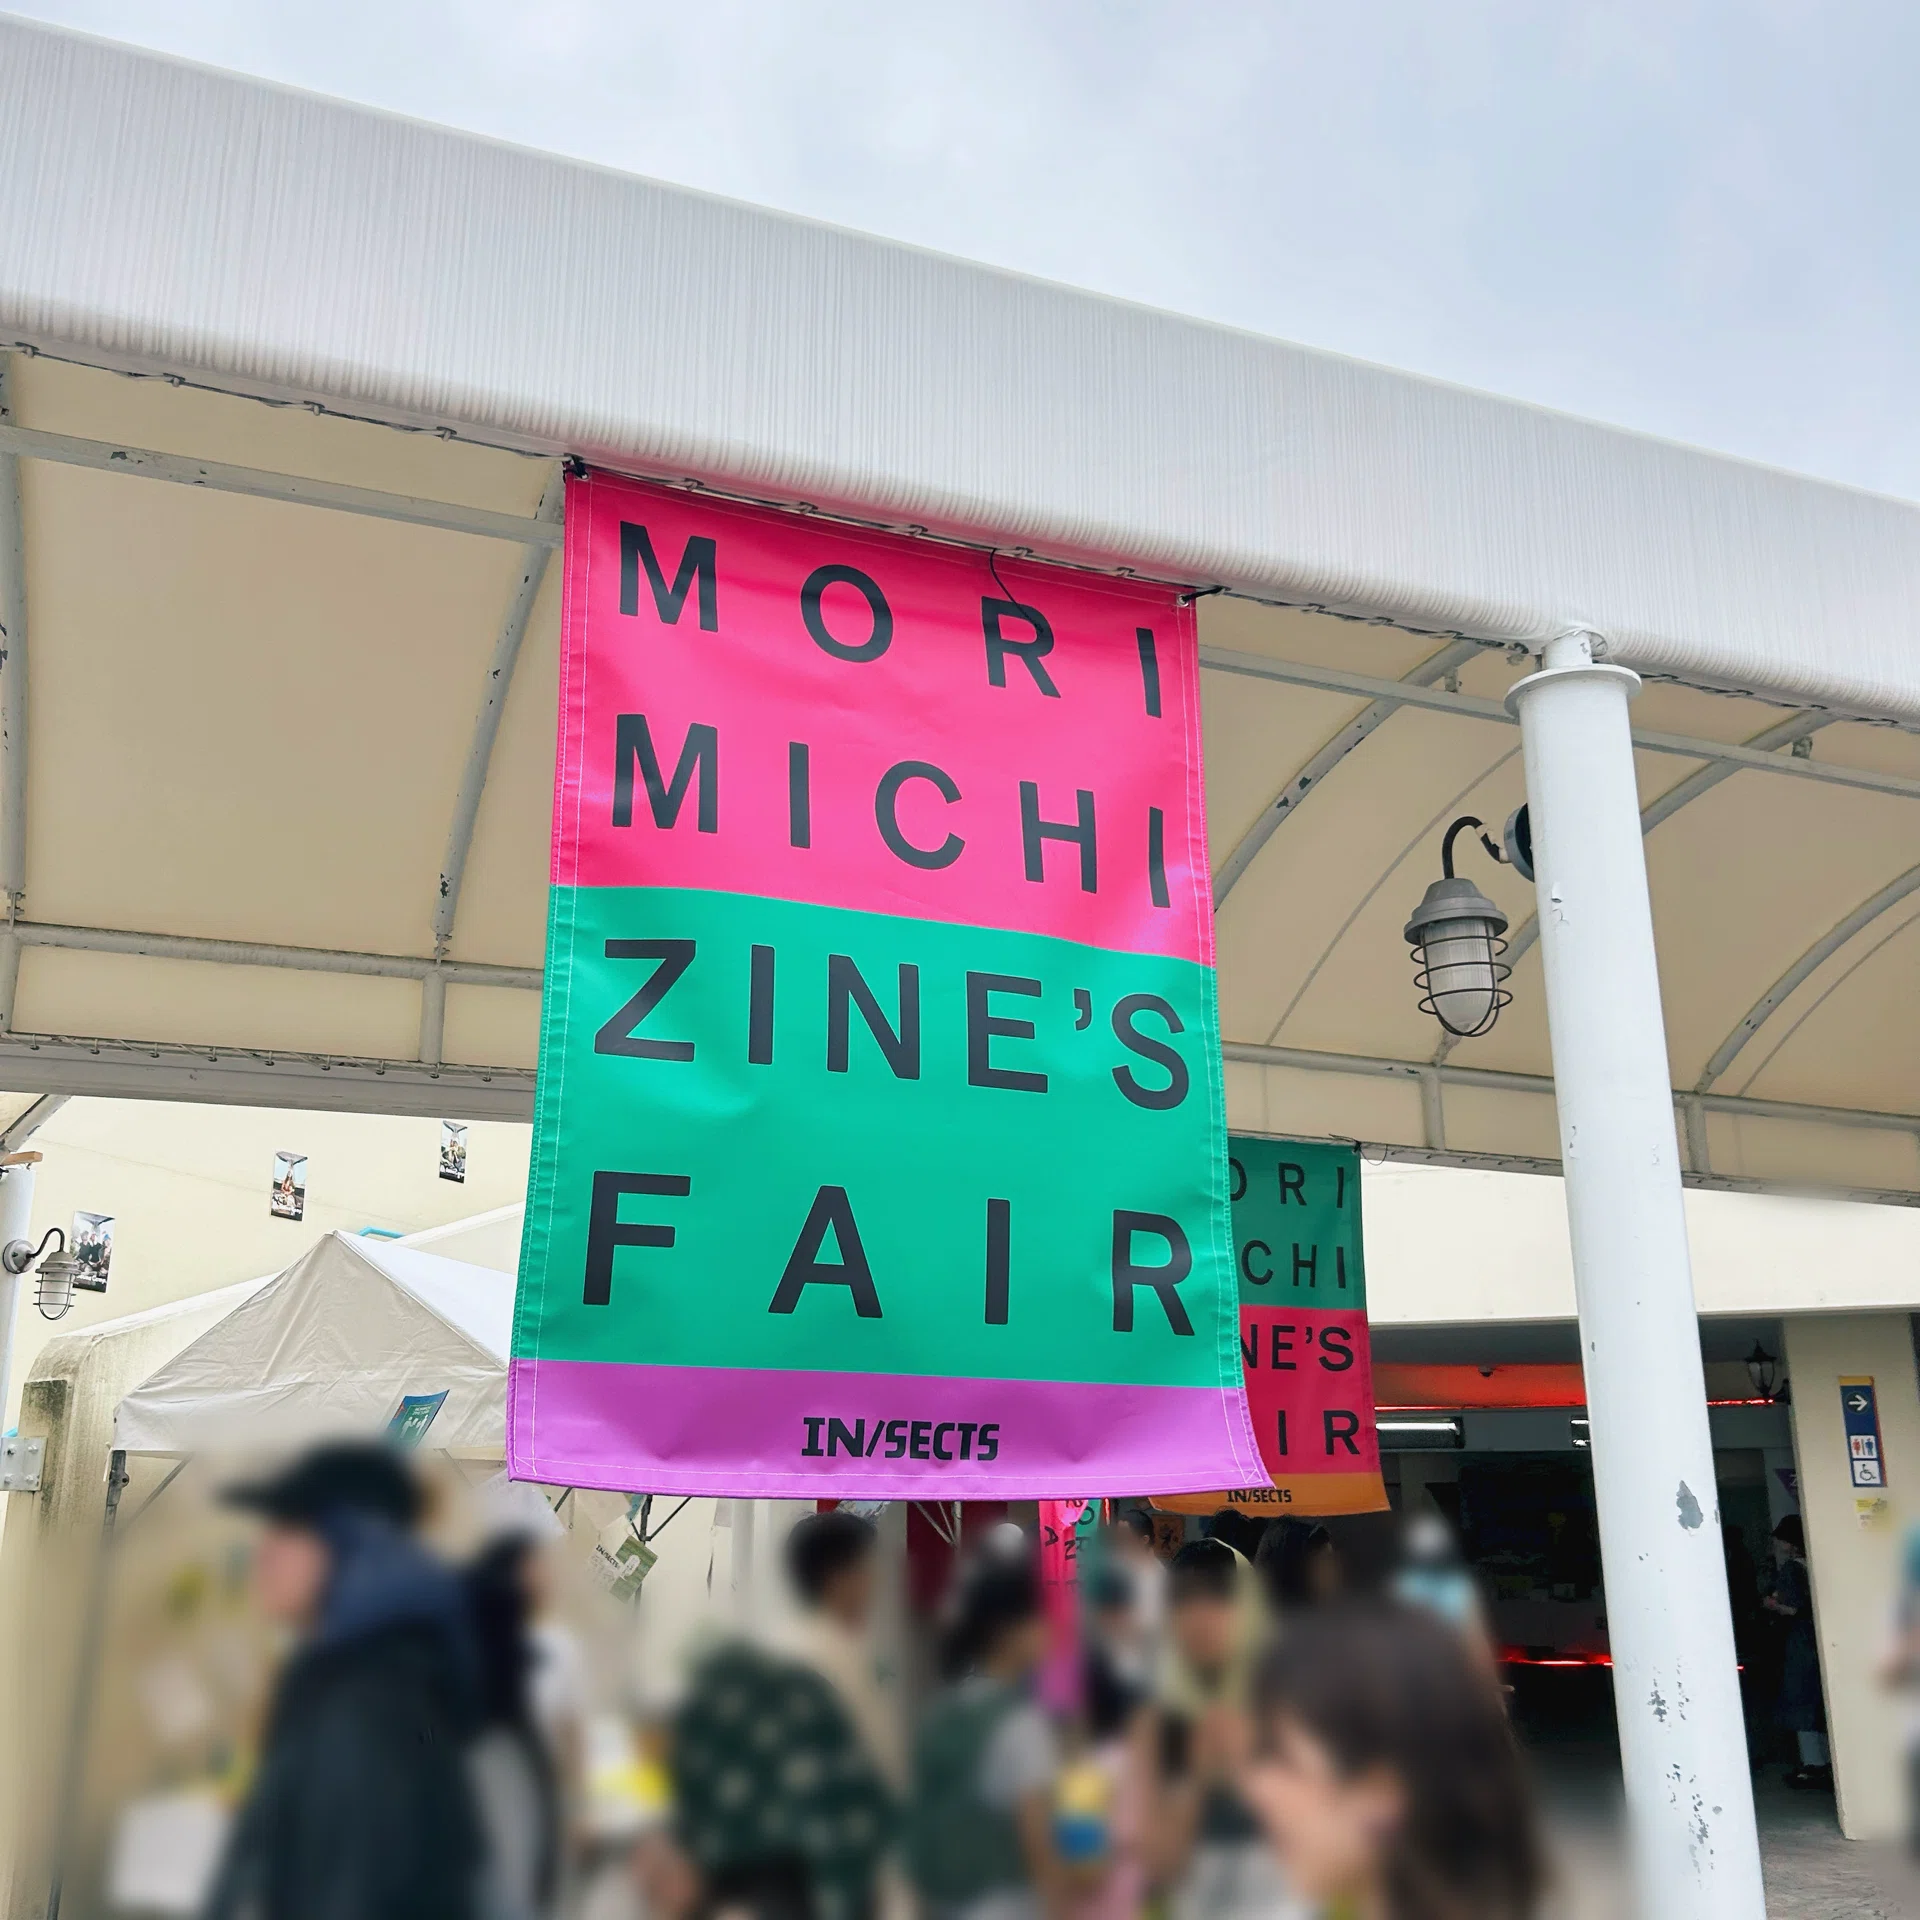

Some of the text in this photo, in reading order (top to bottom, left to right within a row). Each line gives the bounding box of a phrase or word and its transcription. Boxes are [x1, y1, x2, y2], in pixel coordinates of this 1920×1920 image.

[619, 520, 1162, 719] MORI
[611, 713, 1172, 909] MICHI
[594, 939, 1190, 1111] ZINE'S
[1228, 1156, 1345, 1208] ORI
[583, 1170, 1196, 1337] FAIR
[1241, 1239, 1346, 1289] CHI
[1240, 1324, 1354, 1371] NE'S
[801, 1417, 1000, 1461] IN/SECTS
[1277, 1409, 1360, 1456] IR
